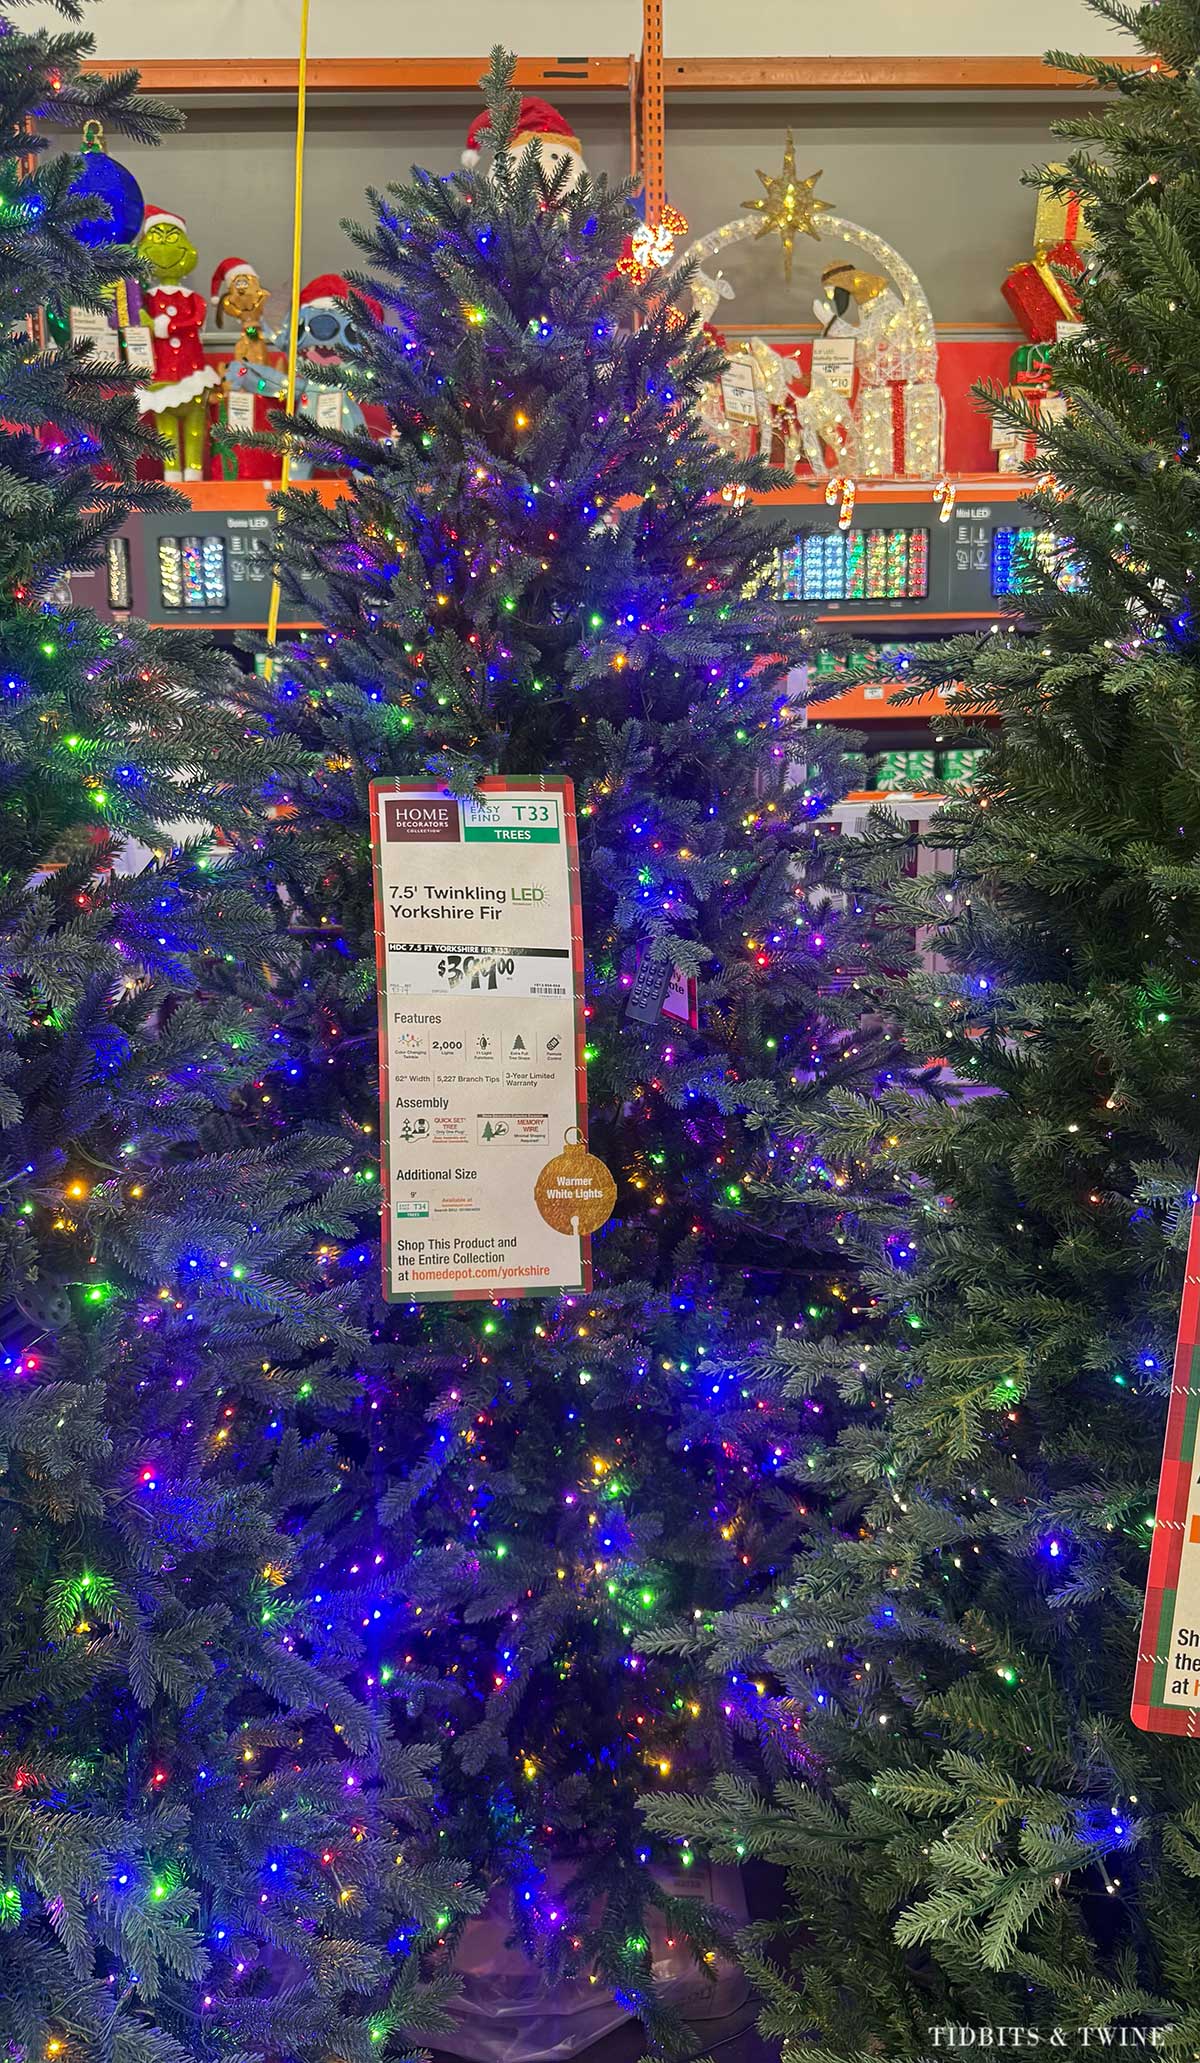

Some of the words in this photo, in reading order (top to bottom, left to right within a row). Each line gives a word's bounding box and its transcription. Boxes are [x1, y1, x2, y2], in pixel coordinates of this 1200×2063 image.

[971, 508, 990, 518] LED
[395, 808, 449, 821] HOME
[470, 805, 500, 814] EASY
[511, 805, 549, 821] T33
[471, 814, 501, 822] FIND
[493, 829, 532, 840] TREES
[389, 885, 418, 899] 7.5'
[423, 885, 506, 904] Twinkling
[511, 887, 545, 902] LED
[389, 904, 474, 919] Yorkshire
[480, 906, 503, 920] Fir
[435, 945, 479, 953] YORKSHIRE
[394, 1012, 442, 1024] Features
[432, 1041, 462, 1051] 2,000
[437, 1075, 457, 1084] 5,227
[458, 1075, 484, 1083] Branch
[485, 1075, 501, 1083] Tips
[506, 1080, 538, 1088] Warranty
[395, 1096, 449, 1111] Assembly
[396, 1168, 451, 1180] Additional
[455, 1168, 478, 1180] Size
[556, 1176, 593, 1186] Warmer
[546, 1189, 573, 1199] White
[575, 1188, 604, 1200] Lights
[397, 1239, 425, 1253] Shop
[427, 1238, 451, 1250] This
[454, 1237, 495, 1249] Product
[497, 1236, 517, 1248] and
[398, 1254, 416, 1266] the
[418, 1253, 450, 1265] Entire
[453, 1251, 505, 1264] Collection
[397, 1270, 409, 1281] at
[411, 1265, 551, 1281] homedepot.com/yorkshire
[1175, 1652, 1200, 1672] the
[1171, 1678, 1190, 1695] at
